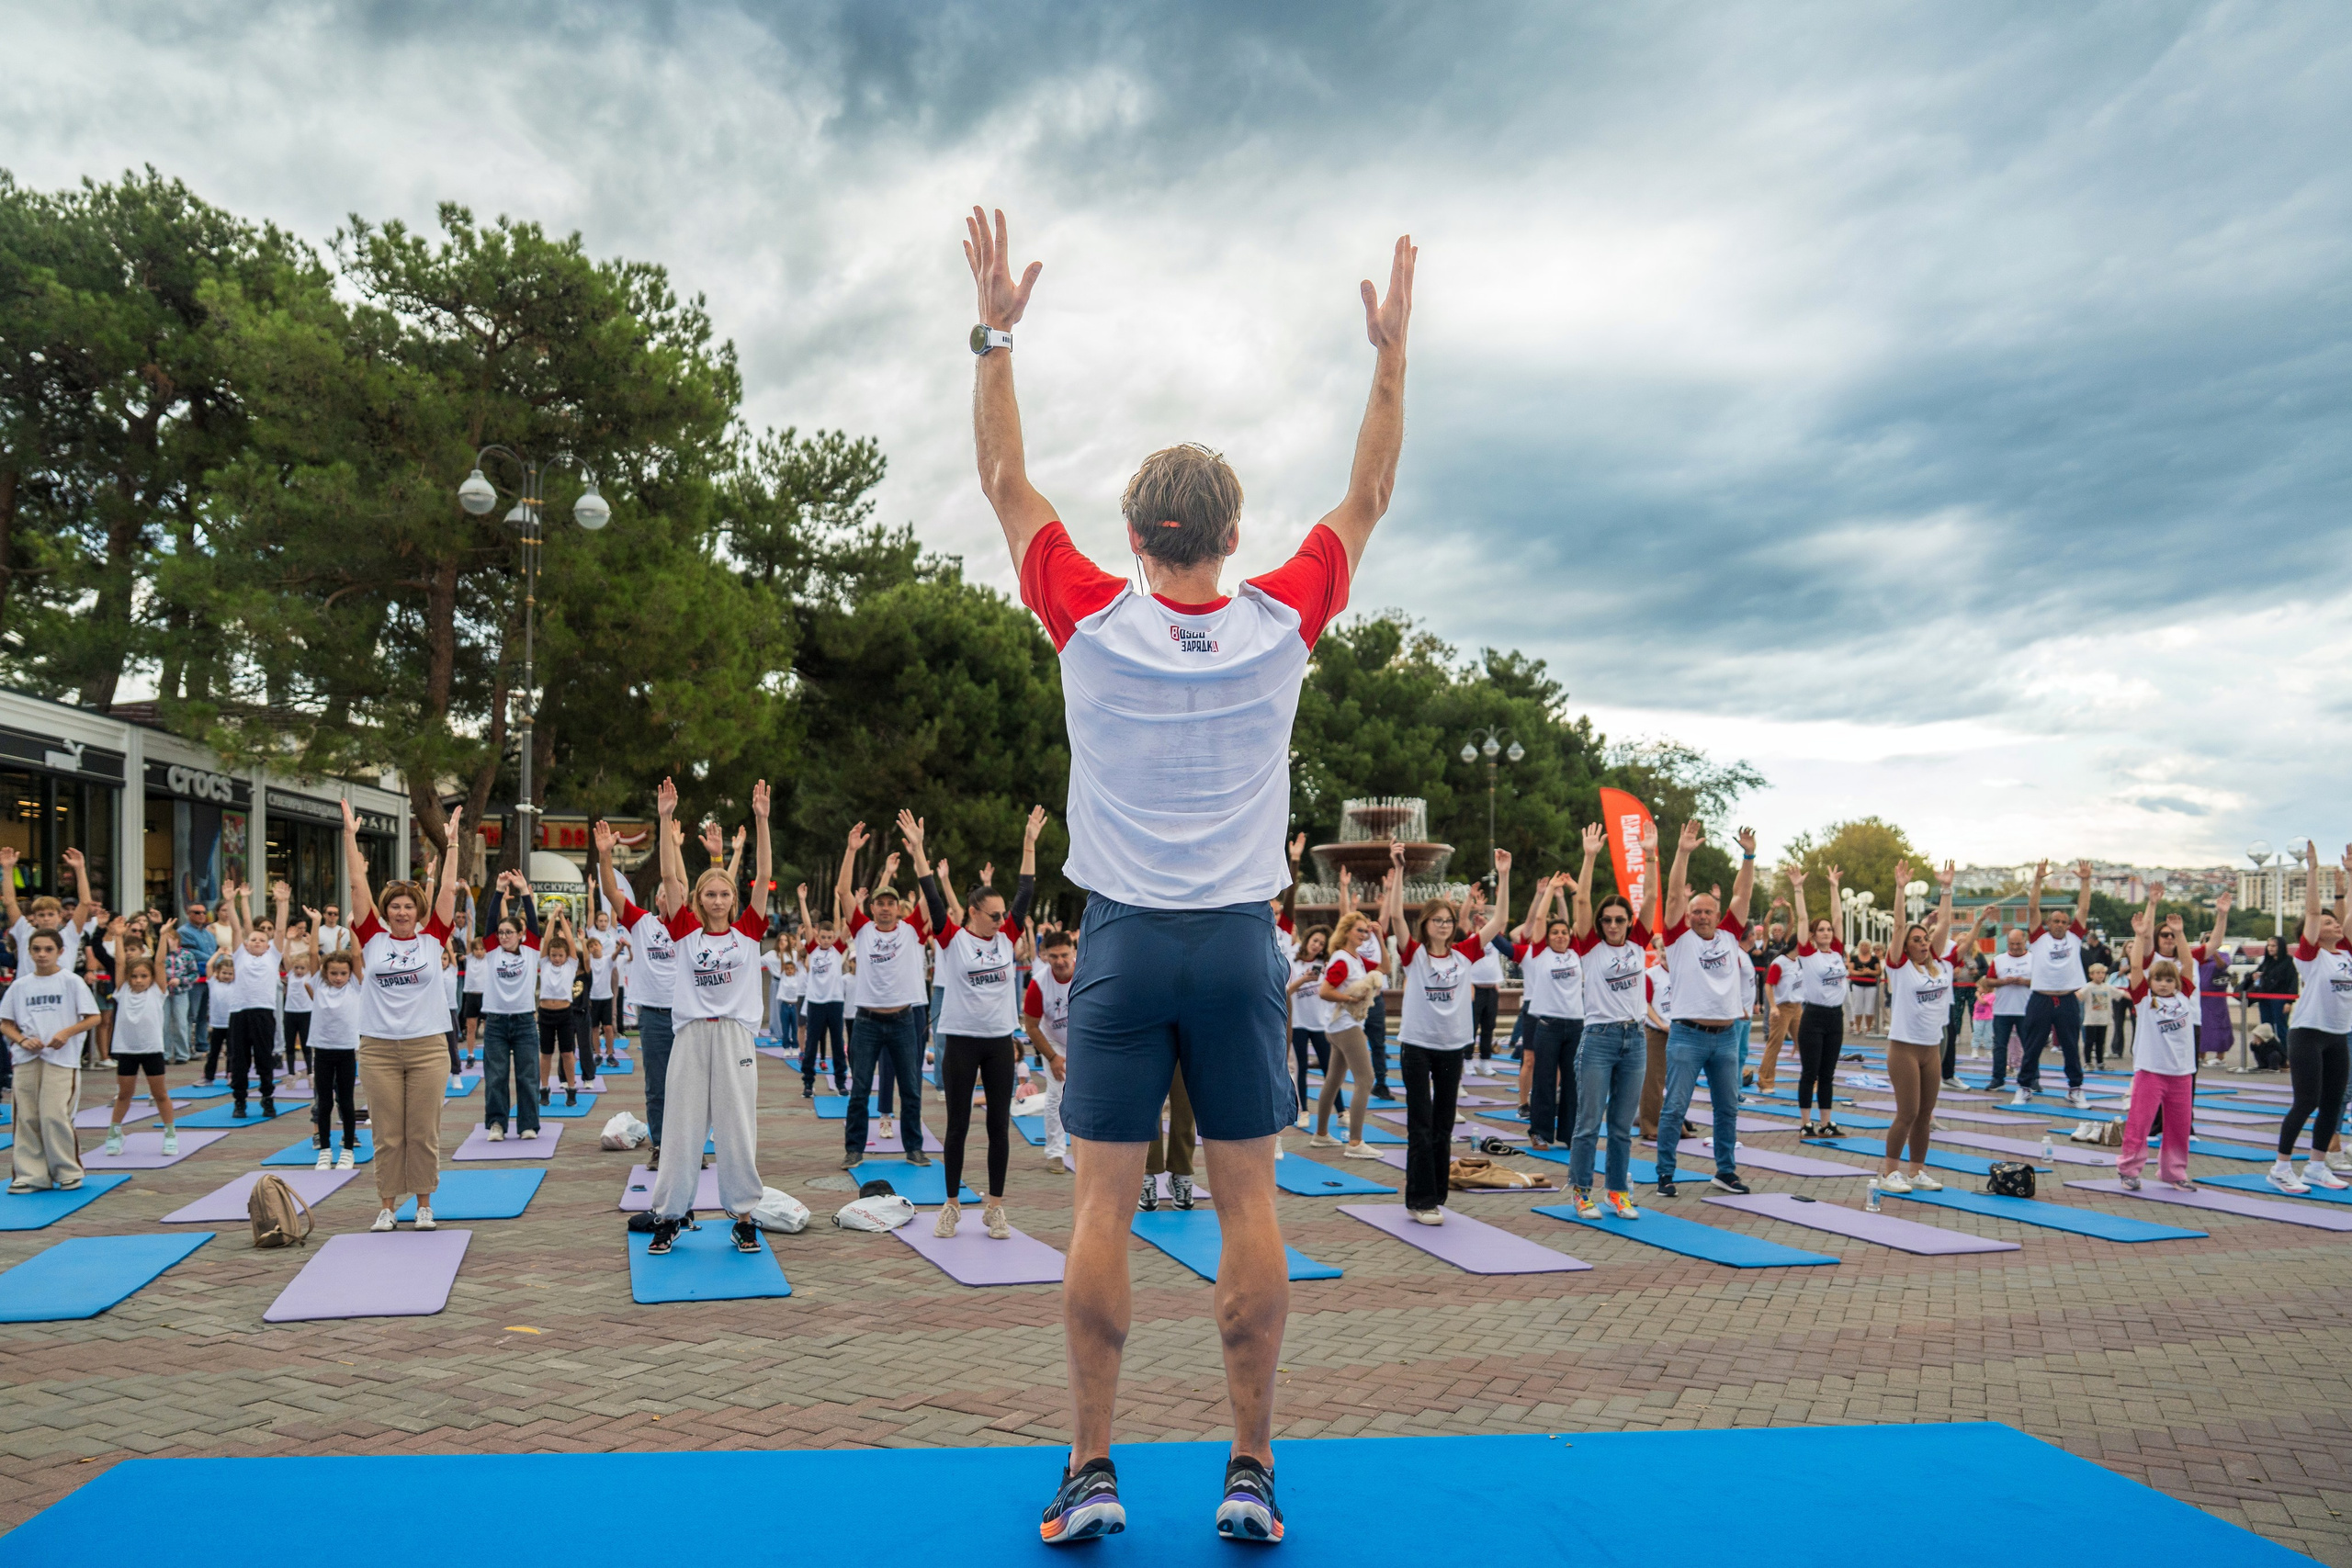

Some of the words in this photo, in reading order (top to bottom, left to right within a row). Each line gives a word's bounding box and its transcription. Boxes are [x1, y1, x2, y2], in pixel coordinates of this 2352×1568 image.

[1182, 640, 1218, 653] ЗАРЯДКА
[167, 765, 233, 803] crocs
[532, 883, 586, 893] ЭКСКУРСИИ
[648, 949, 675, 960] ЗАРЯДКА
[378, 974, 418, 987] ЗАРЯДКА
[695, 972, 731, 987] ЗАРЯДКА
[969, 971, 1006, 986] ЗАРЯДКА
[2160, 1019, 2186, 1032] АРЯДКА
